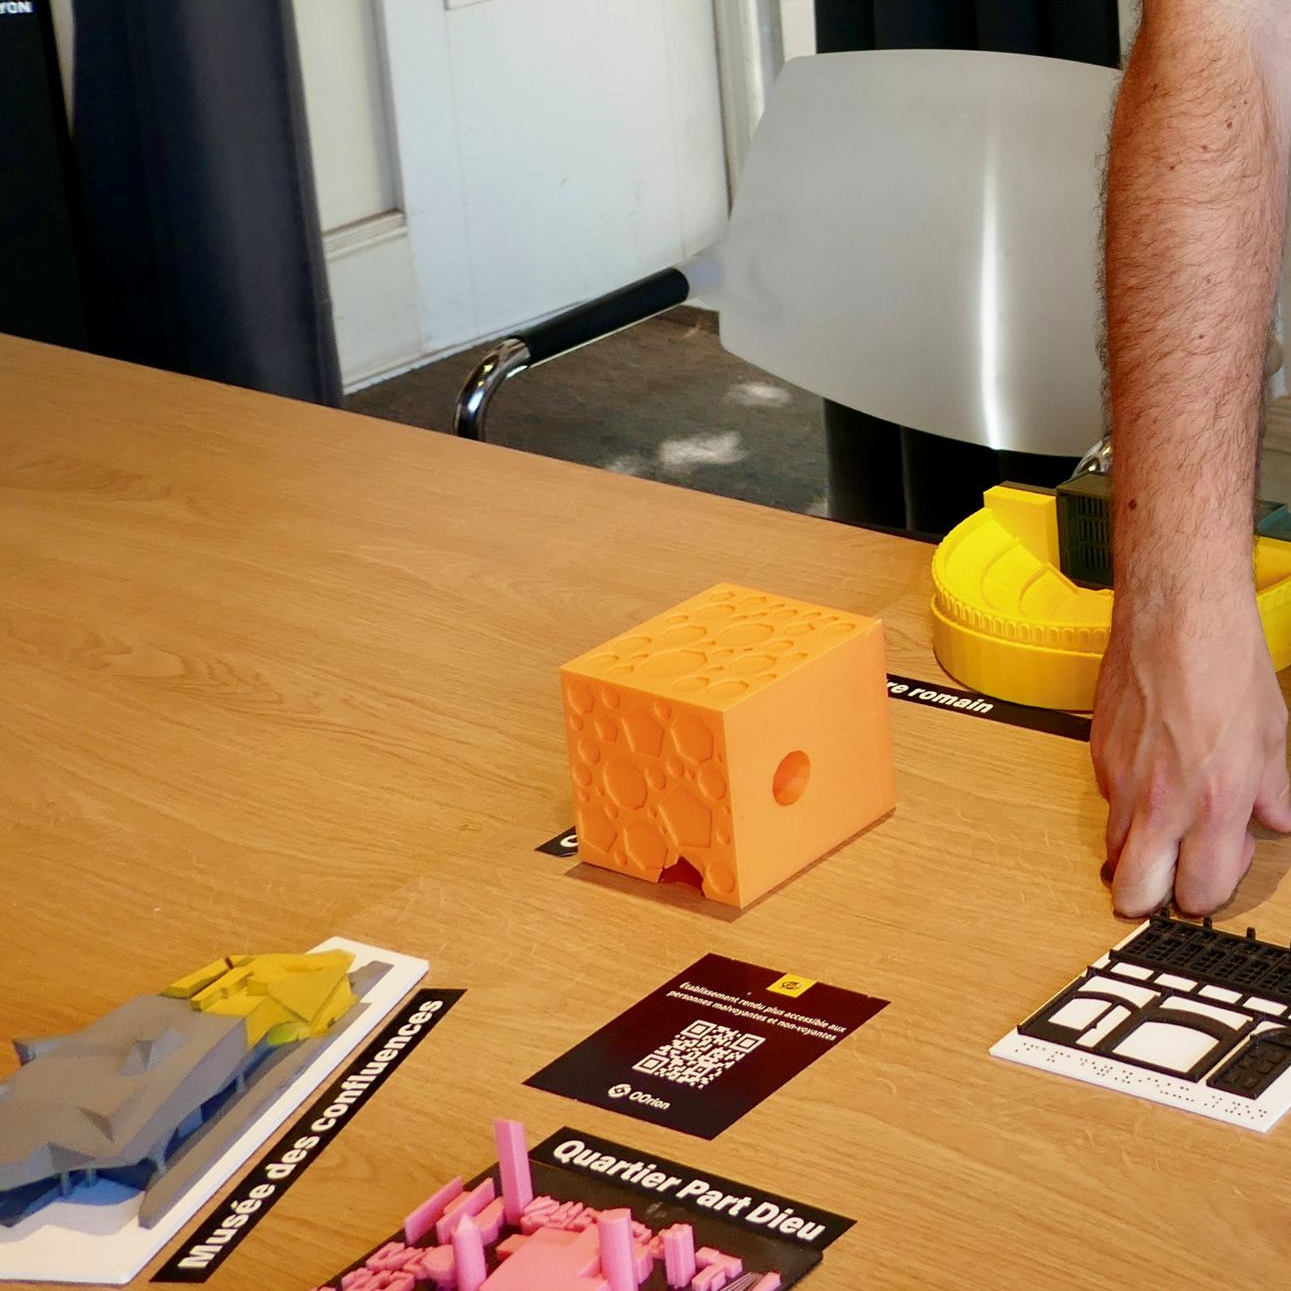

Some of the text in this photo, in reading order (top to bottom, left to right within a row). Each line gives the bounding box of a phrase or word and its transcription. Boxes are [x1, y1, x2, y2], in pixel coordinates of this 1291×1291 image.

[908, 688, 994, 715] romain
[665, 988, 838, 1042] personnes malvoyantes et non-voyantes
[739, 994, 765, 1011] rendu
[762, 1002, 785, 1019] plus
[783, 1005, 829, 1029] accessible
[826, 1023, 848, 1034] aux
[177, 999, 444, 1269] Musée des confluences
[553, 1139, 827, 1242] Quartier Part Dieu
